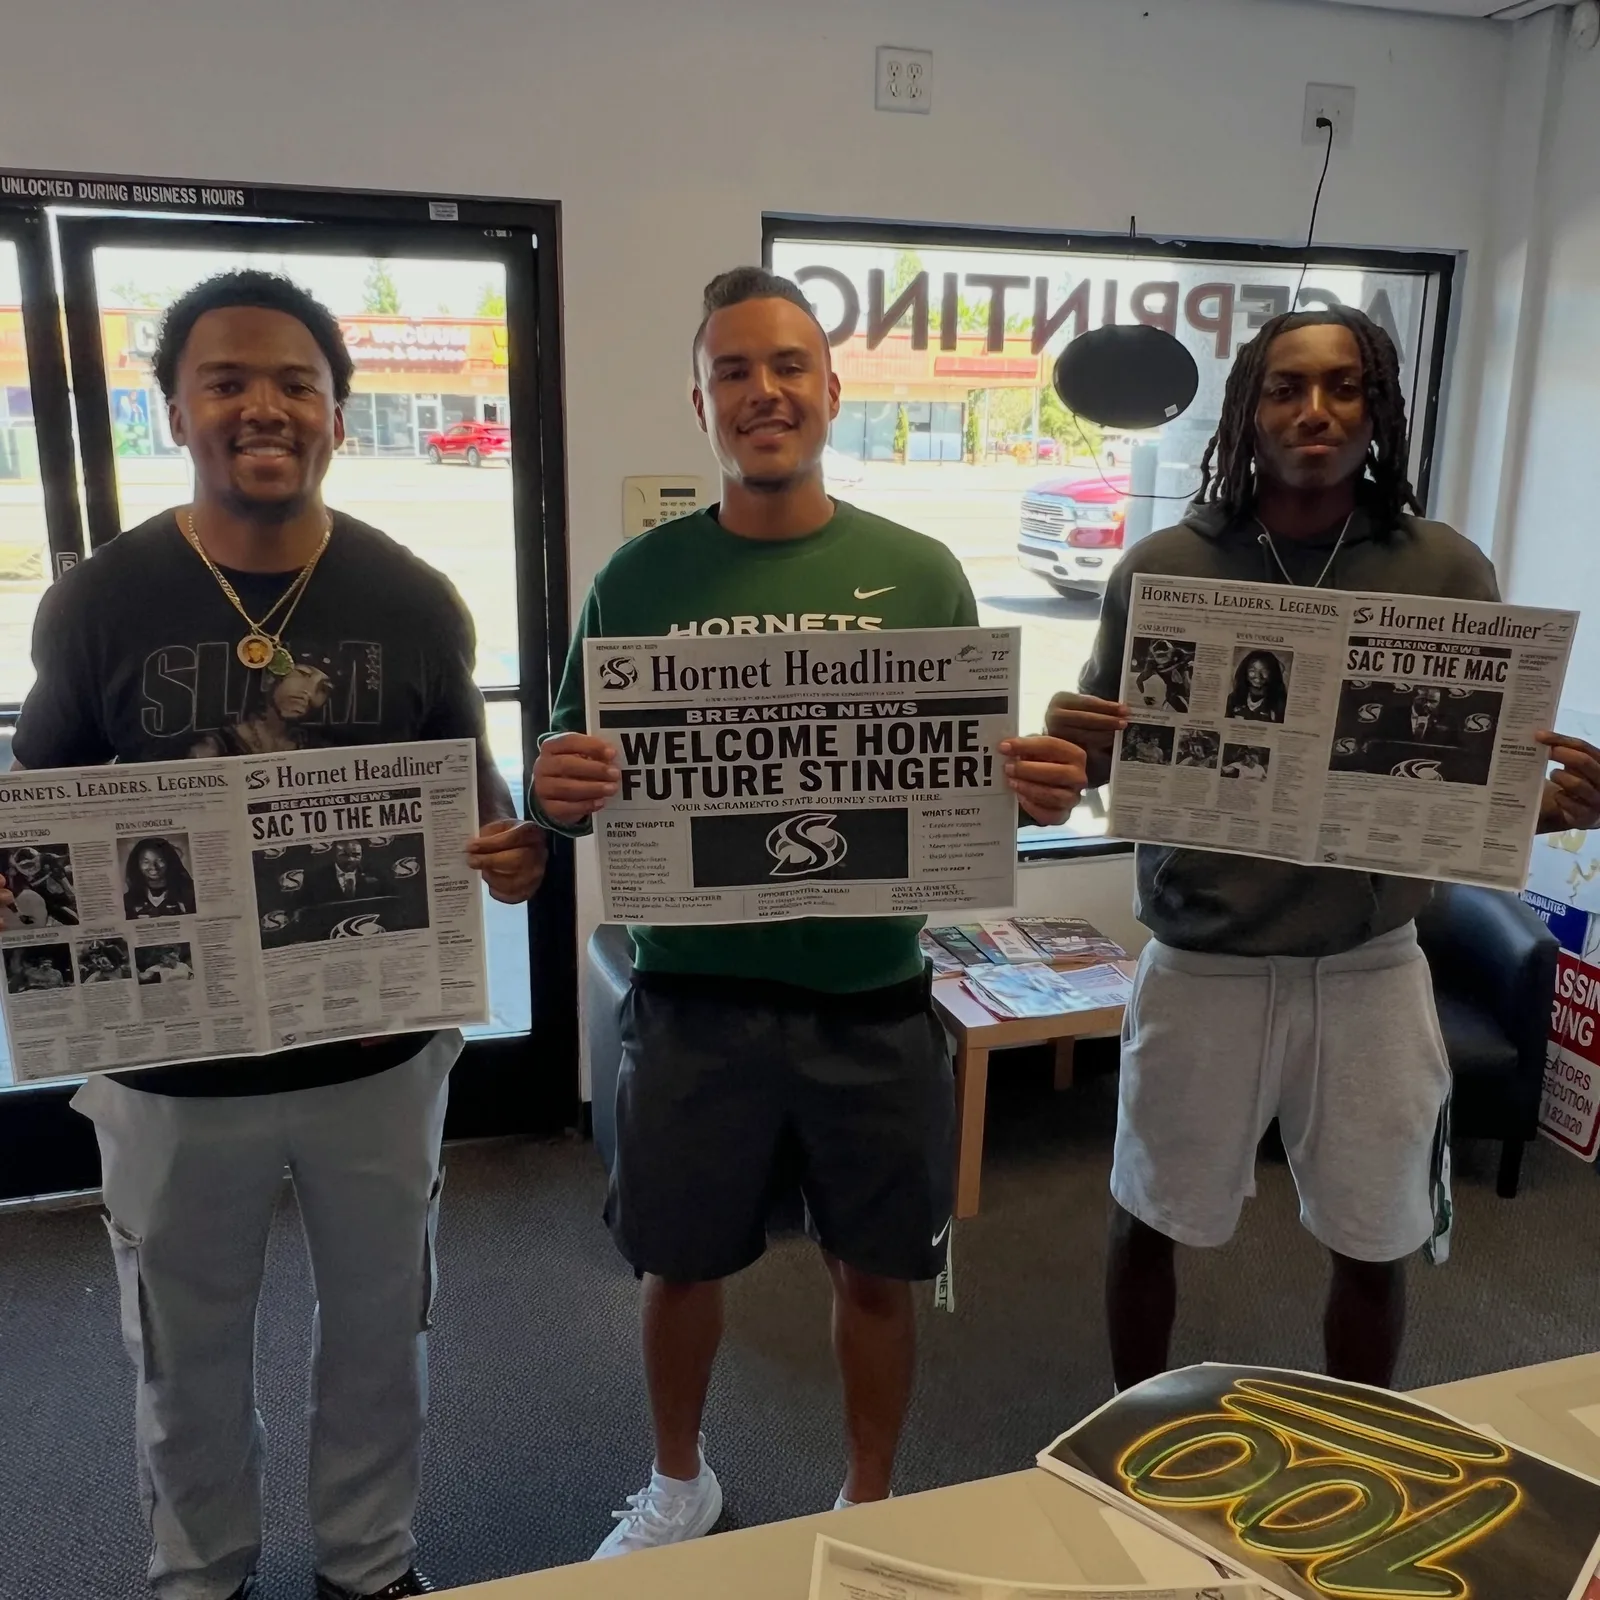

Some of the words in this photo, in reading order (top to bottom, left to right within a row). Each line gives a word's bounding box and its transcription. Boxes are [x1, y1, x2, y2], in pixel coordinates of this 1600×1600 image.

[1, 177, 73, 198] UNLOCKED
[79, 182, 128, 201] DURING
[133, 185, 197, 204] BUSINESS
[201, 188, 245, 206] HOURS
[1141, 586, 1208, 604] HORNETS.
[1214, 592, 1274, 611] LEADERS.
[1279, 598, 1339, 617] LEGENDS.
[666, 613, 884, 637] HORNETS
[1379, 606, 1446, 632] Hornet
[1451, 612, 1541, 640] Headliner
[1367, 638, 1437, 652] BREAKING
[1441, 644, 1481, 656] NEWS
[651, 655, 772, 692] Hornet
[784, 648, 952, 687] Headliner
[1346, 649, 1385, 672] SAC
[1392, 652, 1415, 675] TO
[1422, 655, 1460, 678] THE
[1464, 659, 1509, 683] MAC
[686, 703, 827, 725] BREAKING
[837, 701, 919, 719] NEWS
[620, 725, 839, 766] WELCOME
[856, 719, 990, 757] HOME,
[76, 780, 152, 798] LEADERS.
[157, 775, 229, 792] LEGENDS.
[276, 765, 348, 789] Hornet
[354, 755, 444, 781] Headliner
[621, 763, 784, 801] FUTURE
[799, 755, 994, 793] STINGER!
[270, 796, 345, 812] BREAKING
[348, 791, 391, 803] NEWS
[671, 802, 701, 812] YOUR
[703, 799, 779, 811] SACRAMENTO
[782, 797, 813, 808] STATE
[815, 795, 866, 806] JOURNEY
[868, 793, 909, 804] STARTS
[954, 808, 981, 816] NEXT?
[251, 813, 294, 840] SAC
[300, 810, 328, 834] TO
[333, 805, 374, 832] THE
[379, 801, 423, 827] MAC
